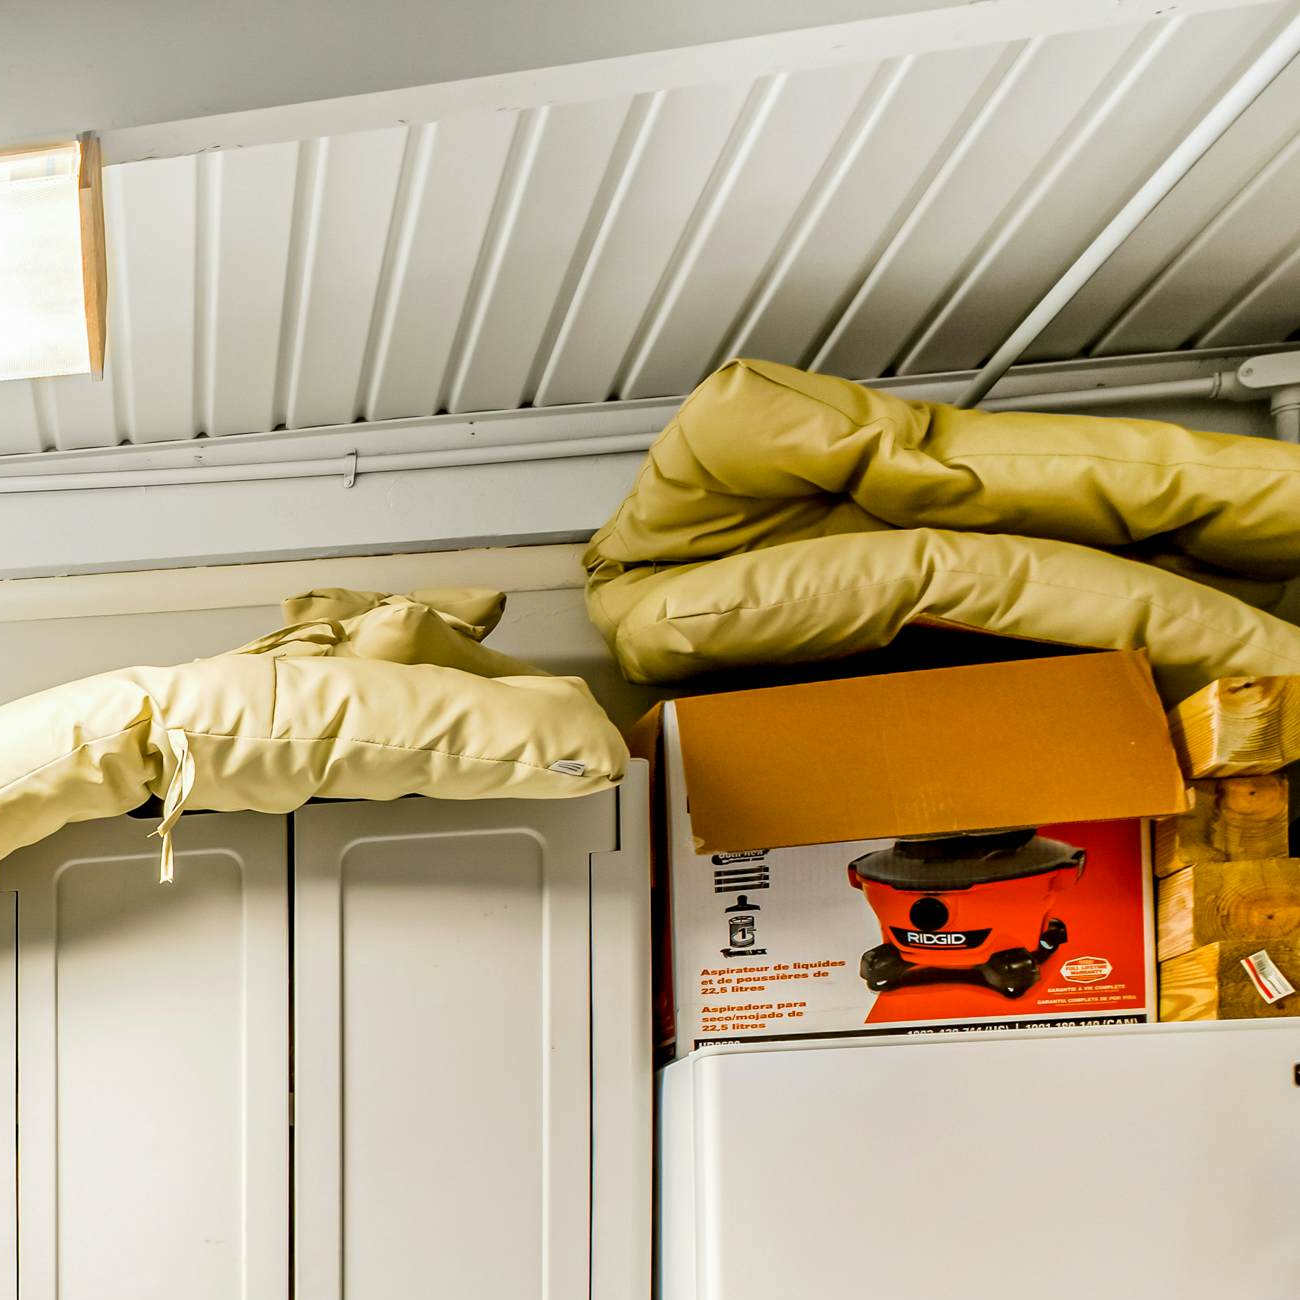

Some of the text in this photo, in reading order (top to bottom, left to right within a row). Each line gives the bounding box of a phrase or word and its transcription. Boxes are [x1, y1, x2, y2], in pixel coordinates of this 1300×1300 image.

[907, 932, 966, 944] RIDGID
[701, 960, 846, 976] Aspirateur de liquides
[701, 978, 713, 986] et
[736, 973, 808, 984] poussières
[813, 970, 829, 978] de
[701, 985, 765, 995] 22,5 litres
[701, 1001, 807, 1014] Aspiradora para
[702, 1010, 804, 1023] seco/mojado de
[702, 1022, 766, 1032] 22,5 litros
